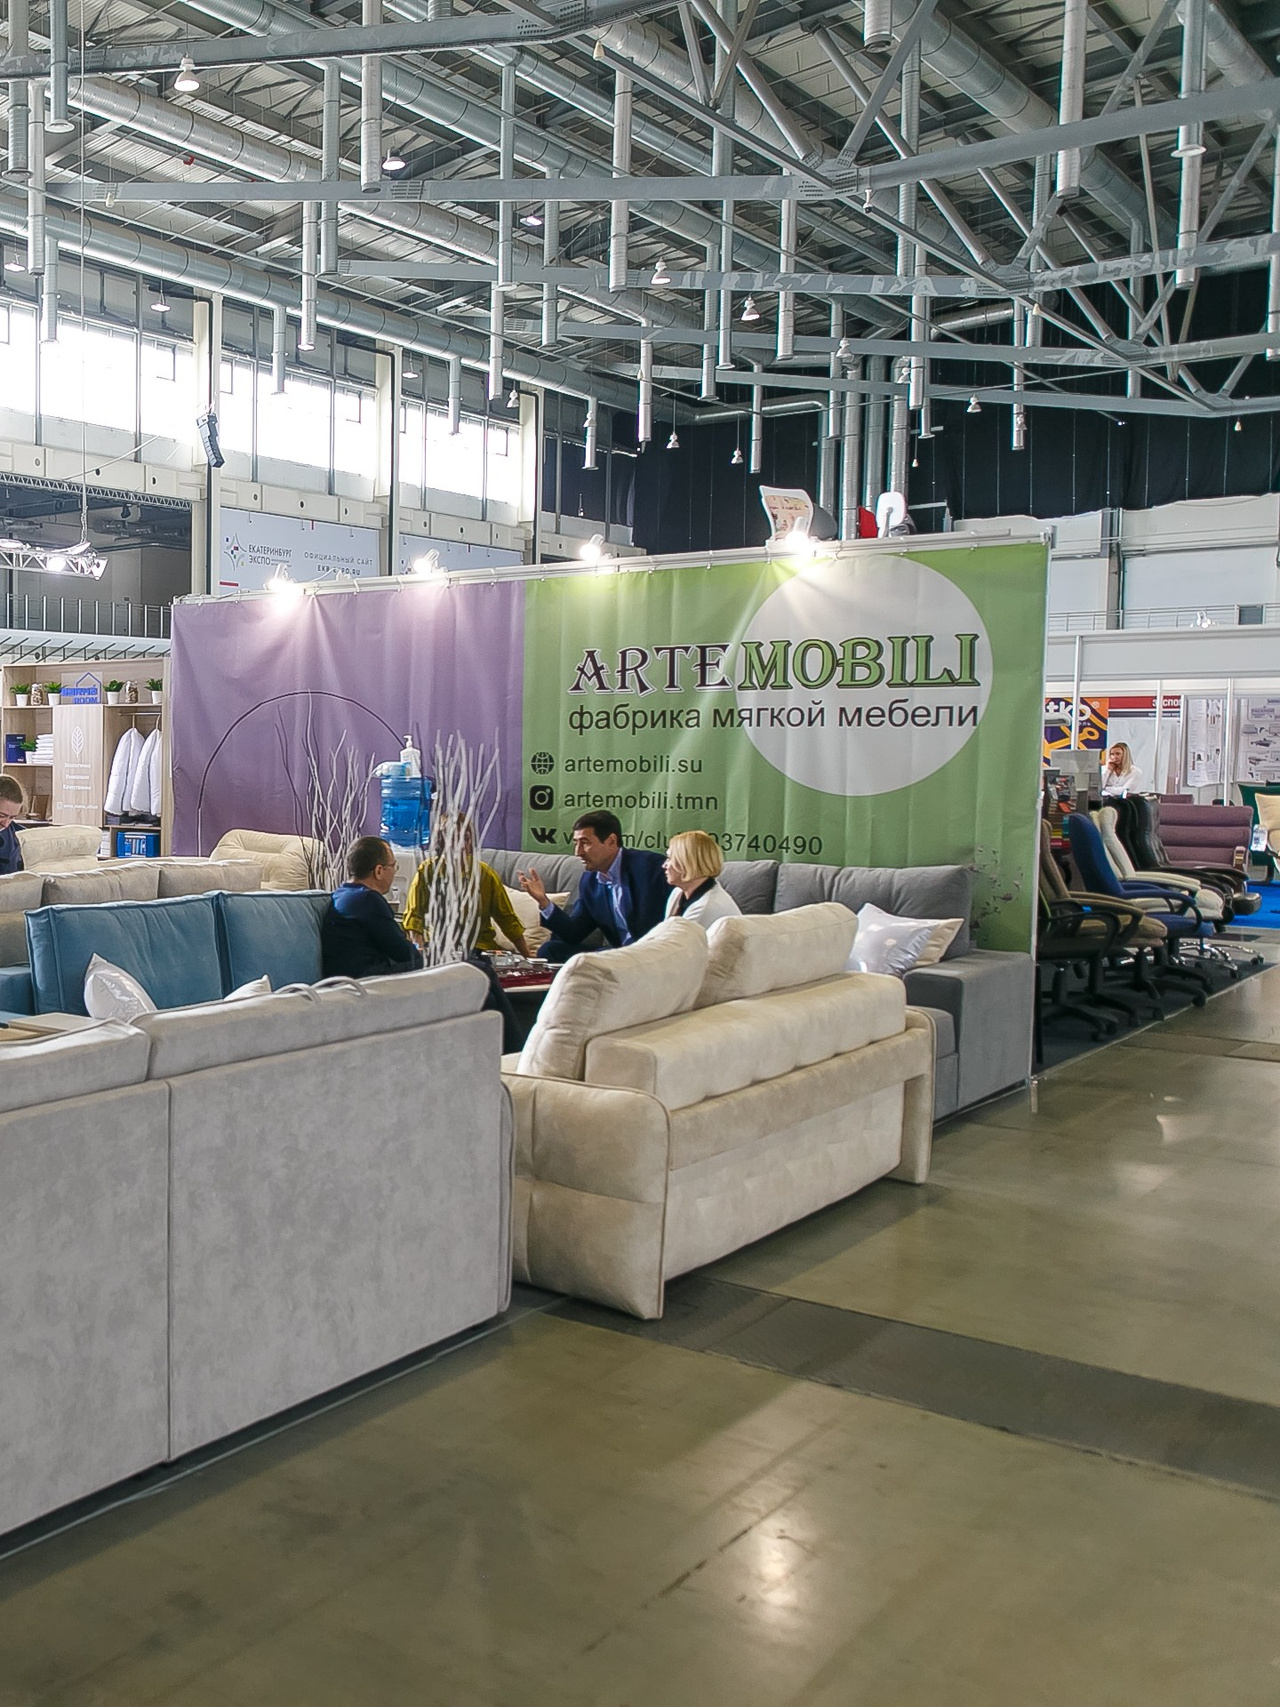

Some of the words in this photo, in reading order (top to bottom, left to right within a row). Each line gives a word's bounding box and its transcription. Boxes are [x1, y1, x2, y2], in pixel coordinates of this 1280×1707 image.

[248, 544, 293, 558] ЕКАТЕРИНБУРГ
[304, 551, 355, 564] ОФИЦИАЛЬНЫЙ
[357, 557, 373, 566] САЙТ
[248, 554, 271, 566] ЭКСПО
[568, 703, 701, 735] фабрика
[712, 700, 826, 729] мягкой
[838, 699, 978, 728] мебели
[564, 754, 703, 773] artemobili.su
[564, 790, 718, 811] artemobili.tmn
